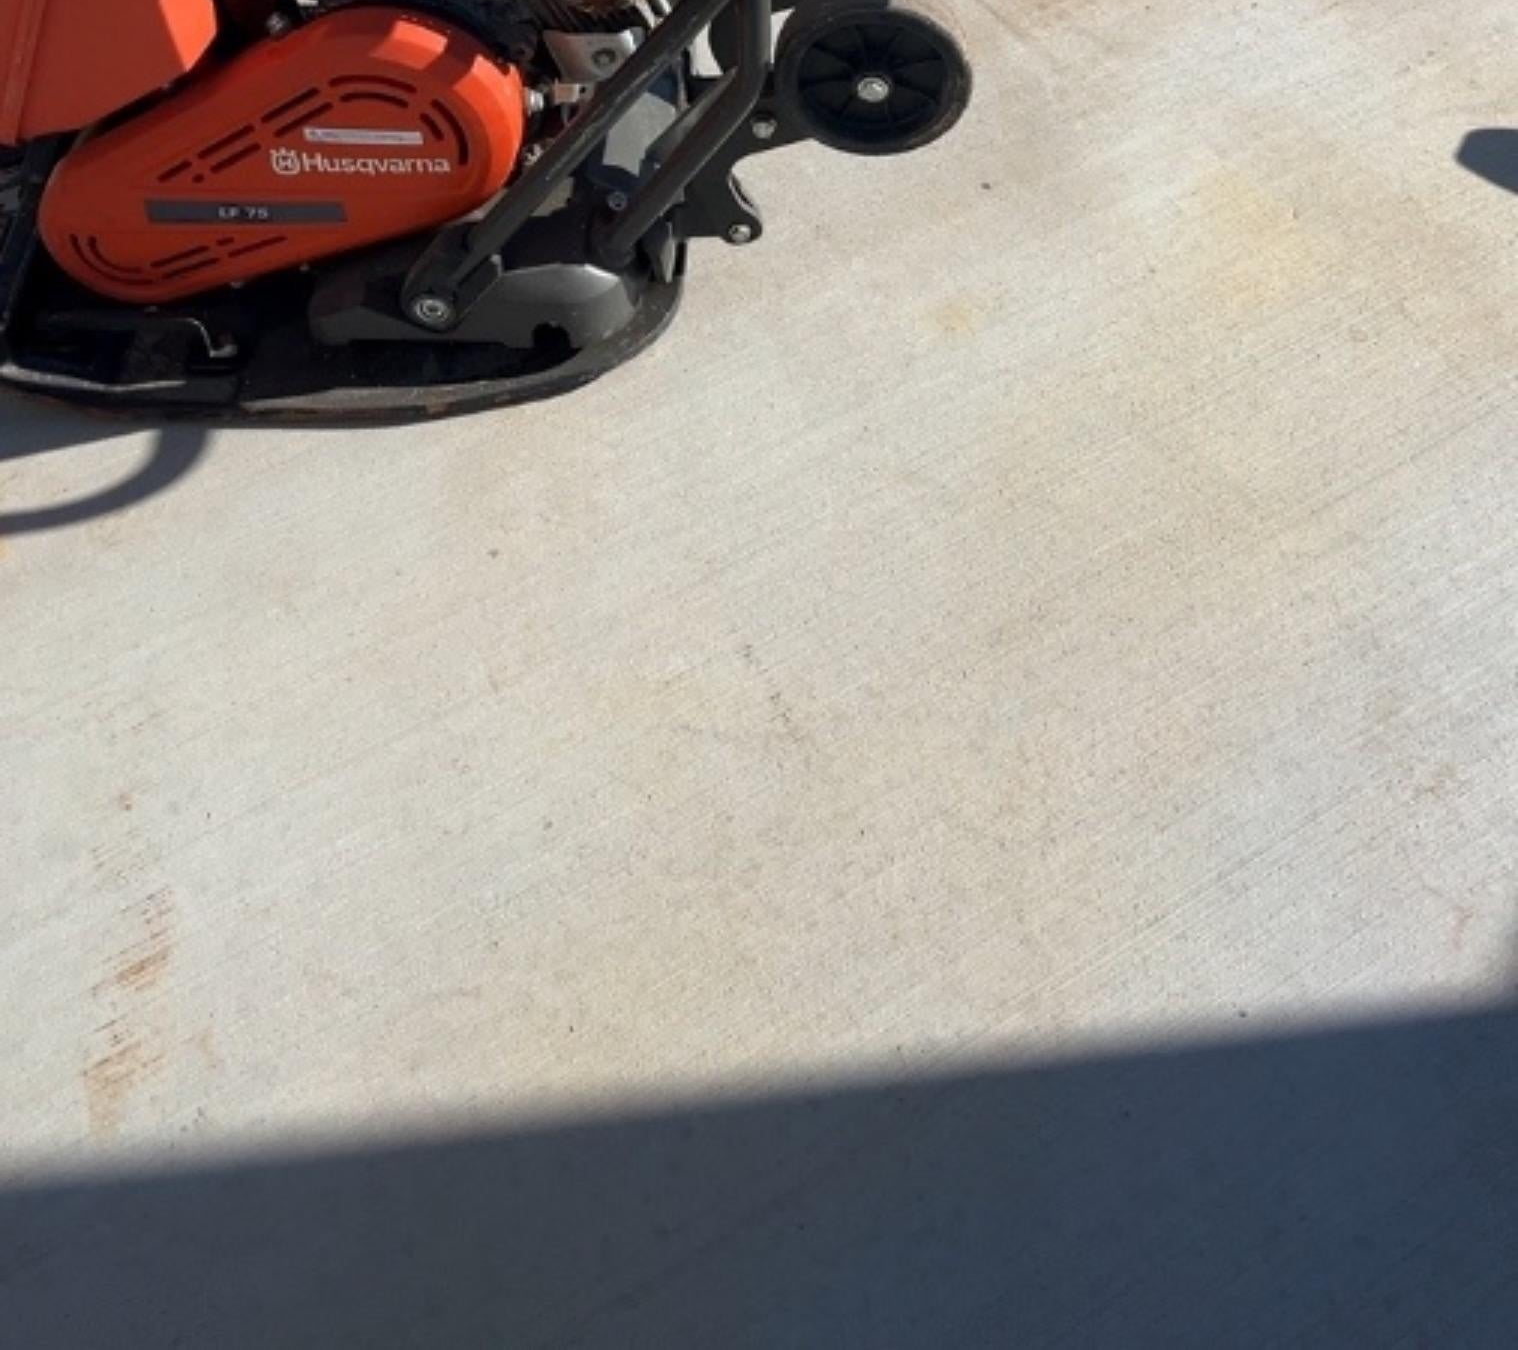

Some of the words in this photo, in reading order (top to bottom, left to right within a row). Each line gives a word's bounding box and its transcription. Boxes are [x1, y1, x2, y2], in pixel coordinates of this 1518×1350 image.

[302, 153, 450, 175] Husqvarna
[217, 206, 240, 219] LF
[247, 206, 269, 219] 75
